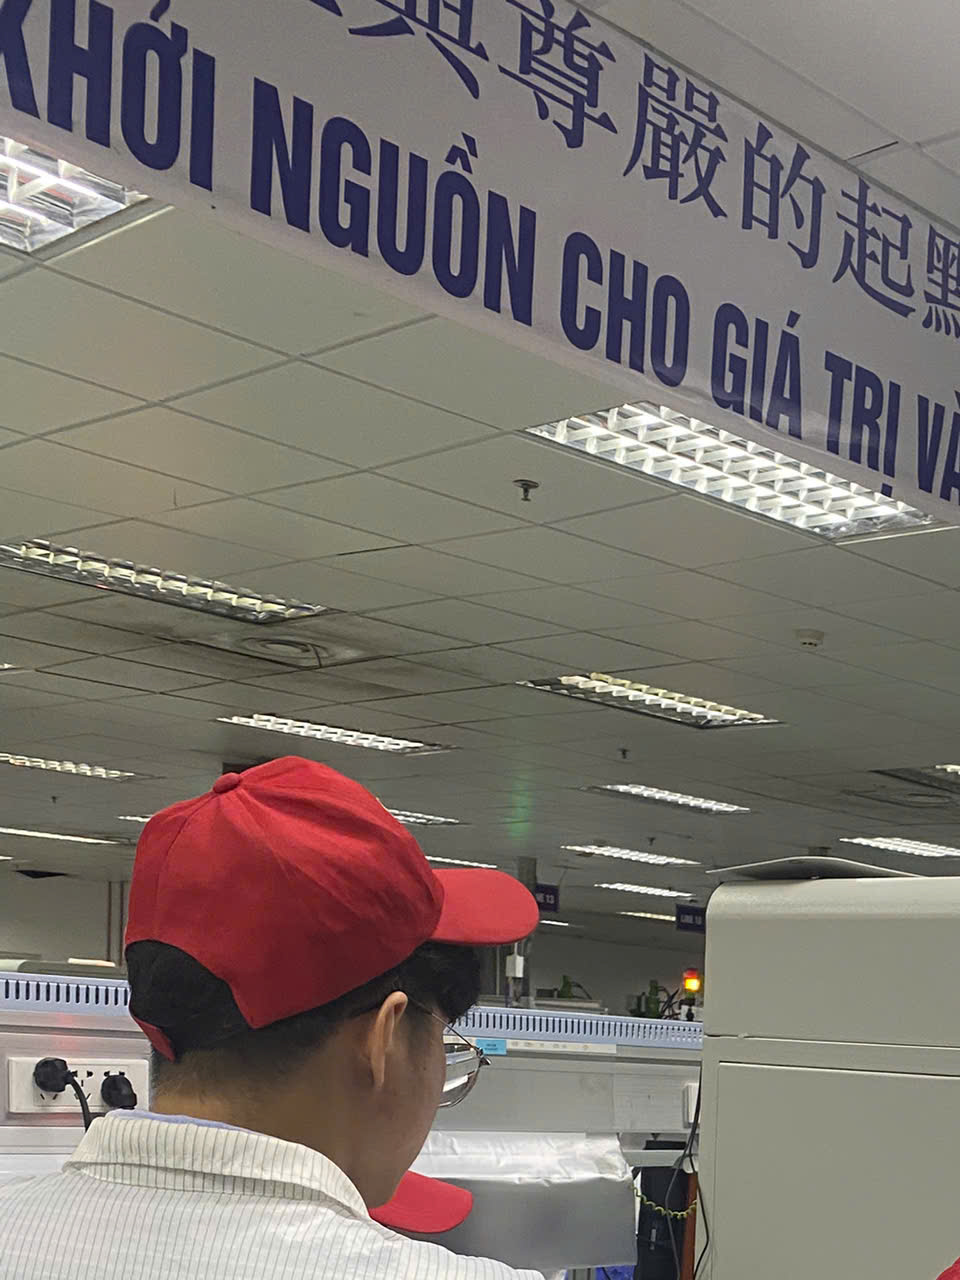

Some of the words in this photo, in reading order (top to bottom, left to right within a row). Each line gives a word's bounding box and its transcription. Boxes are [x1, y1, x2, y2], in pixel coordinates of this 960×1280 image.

[250, 77, 536, 327] NGUỒN
[560, 231, 690, 387] CHO
[711, 303, 803, 440] GIÁ
[824, 351, 901, 497] TRỊ
